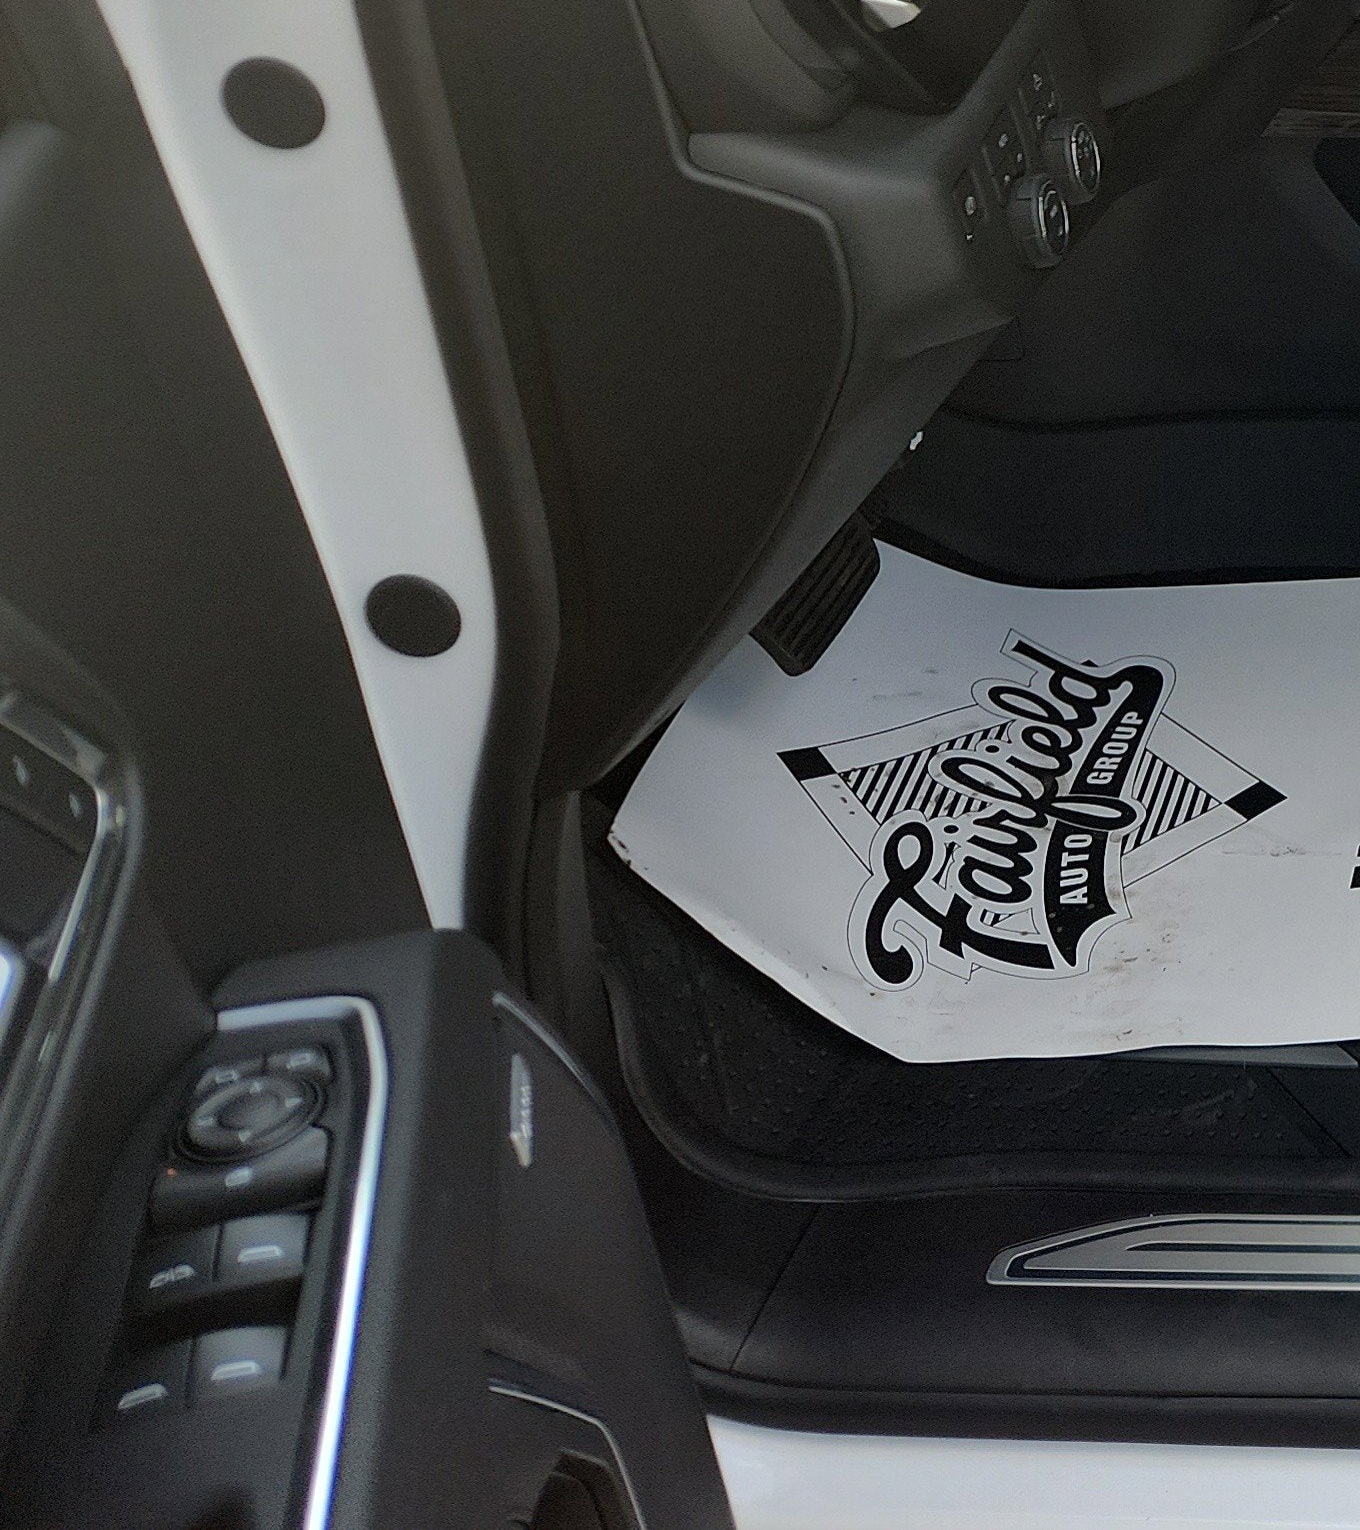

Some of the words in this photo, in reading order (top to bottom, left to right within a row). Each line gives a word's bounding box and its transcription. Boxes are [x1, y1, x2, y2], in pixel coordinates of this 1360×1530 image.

[866, 639, 1163, 984] Fairfield
[1059, 833, 1093, 905] AUTO
[1087, 711, 1144, 785] GROUP
